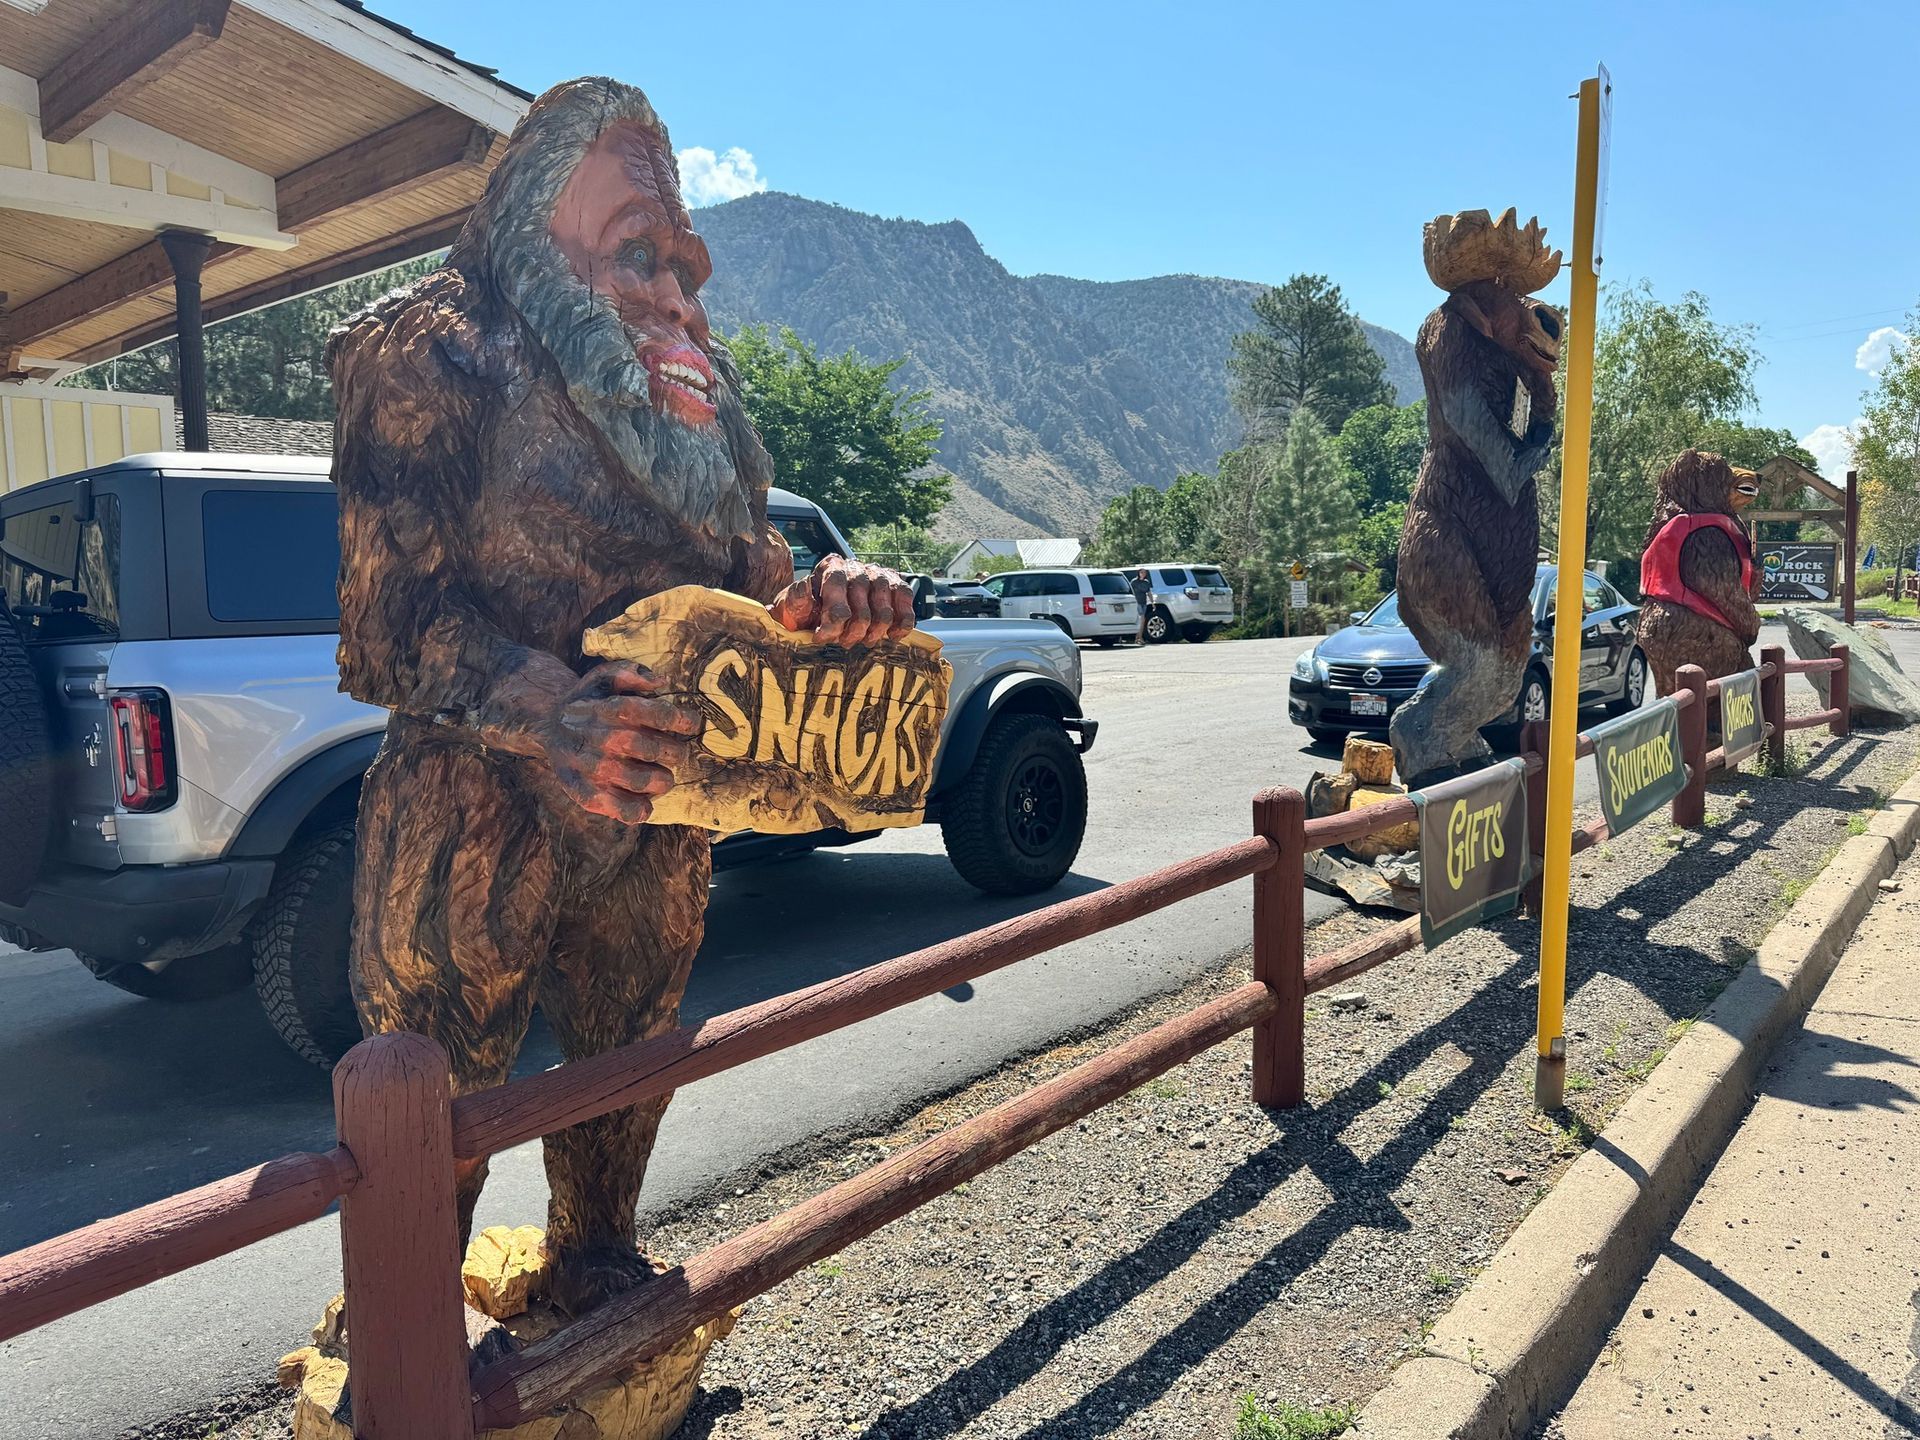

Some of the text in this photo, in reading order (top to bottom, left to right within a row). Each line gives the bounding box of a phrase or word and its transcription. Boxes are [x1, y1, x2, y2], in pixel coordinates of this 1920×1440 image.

[1763, 572, 1826, 583] NTURE
[1784, 561, 1823, 570] ROCK
[699, 649, 936, 795] SNACKS
[1726, 688, 1754, 741] SNACKS
[1607, 731, 1674, 816] SOUVENIRS
[1447, 799, 1505, 890] GIFTS
